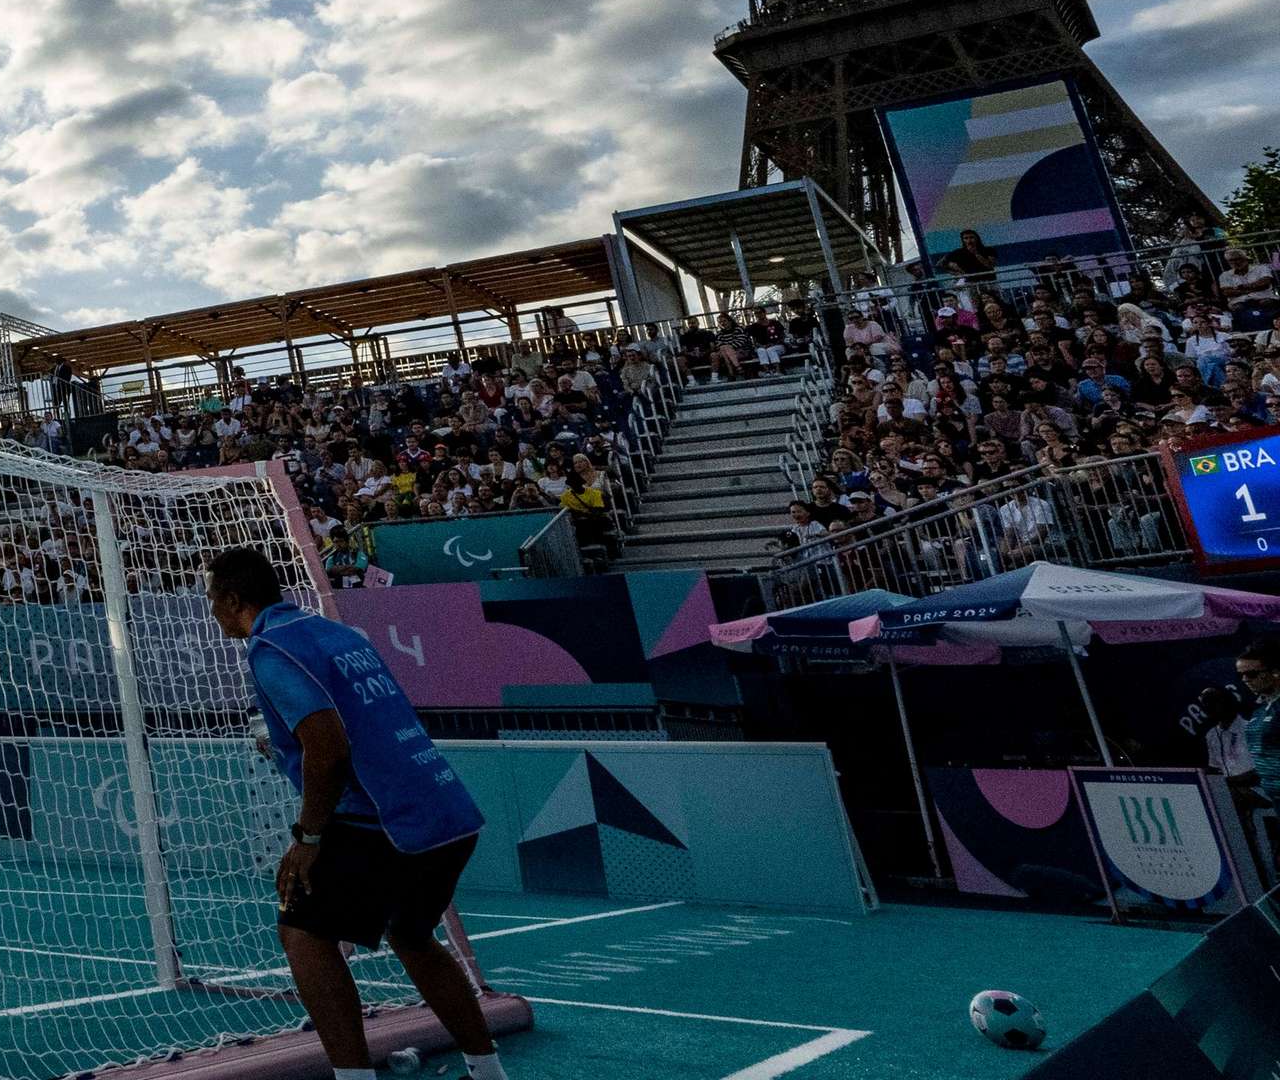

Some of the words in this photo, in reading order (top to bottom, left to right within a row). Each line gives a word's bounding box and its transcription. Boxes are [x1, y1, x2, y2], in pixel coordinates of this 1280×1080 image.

[1222, 447, 1276, 472] BRA
[1234, 483, 1267, 523] 1
[1256, 537, 1269, 552] 0
[904, 610, 948, 625] PARIS
[953, 607, 997, 618] 2024
[29, 633, 204, 676] PAIS
[352, 673, 397, 704] 202
